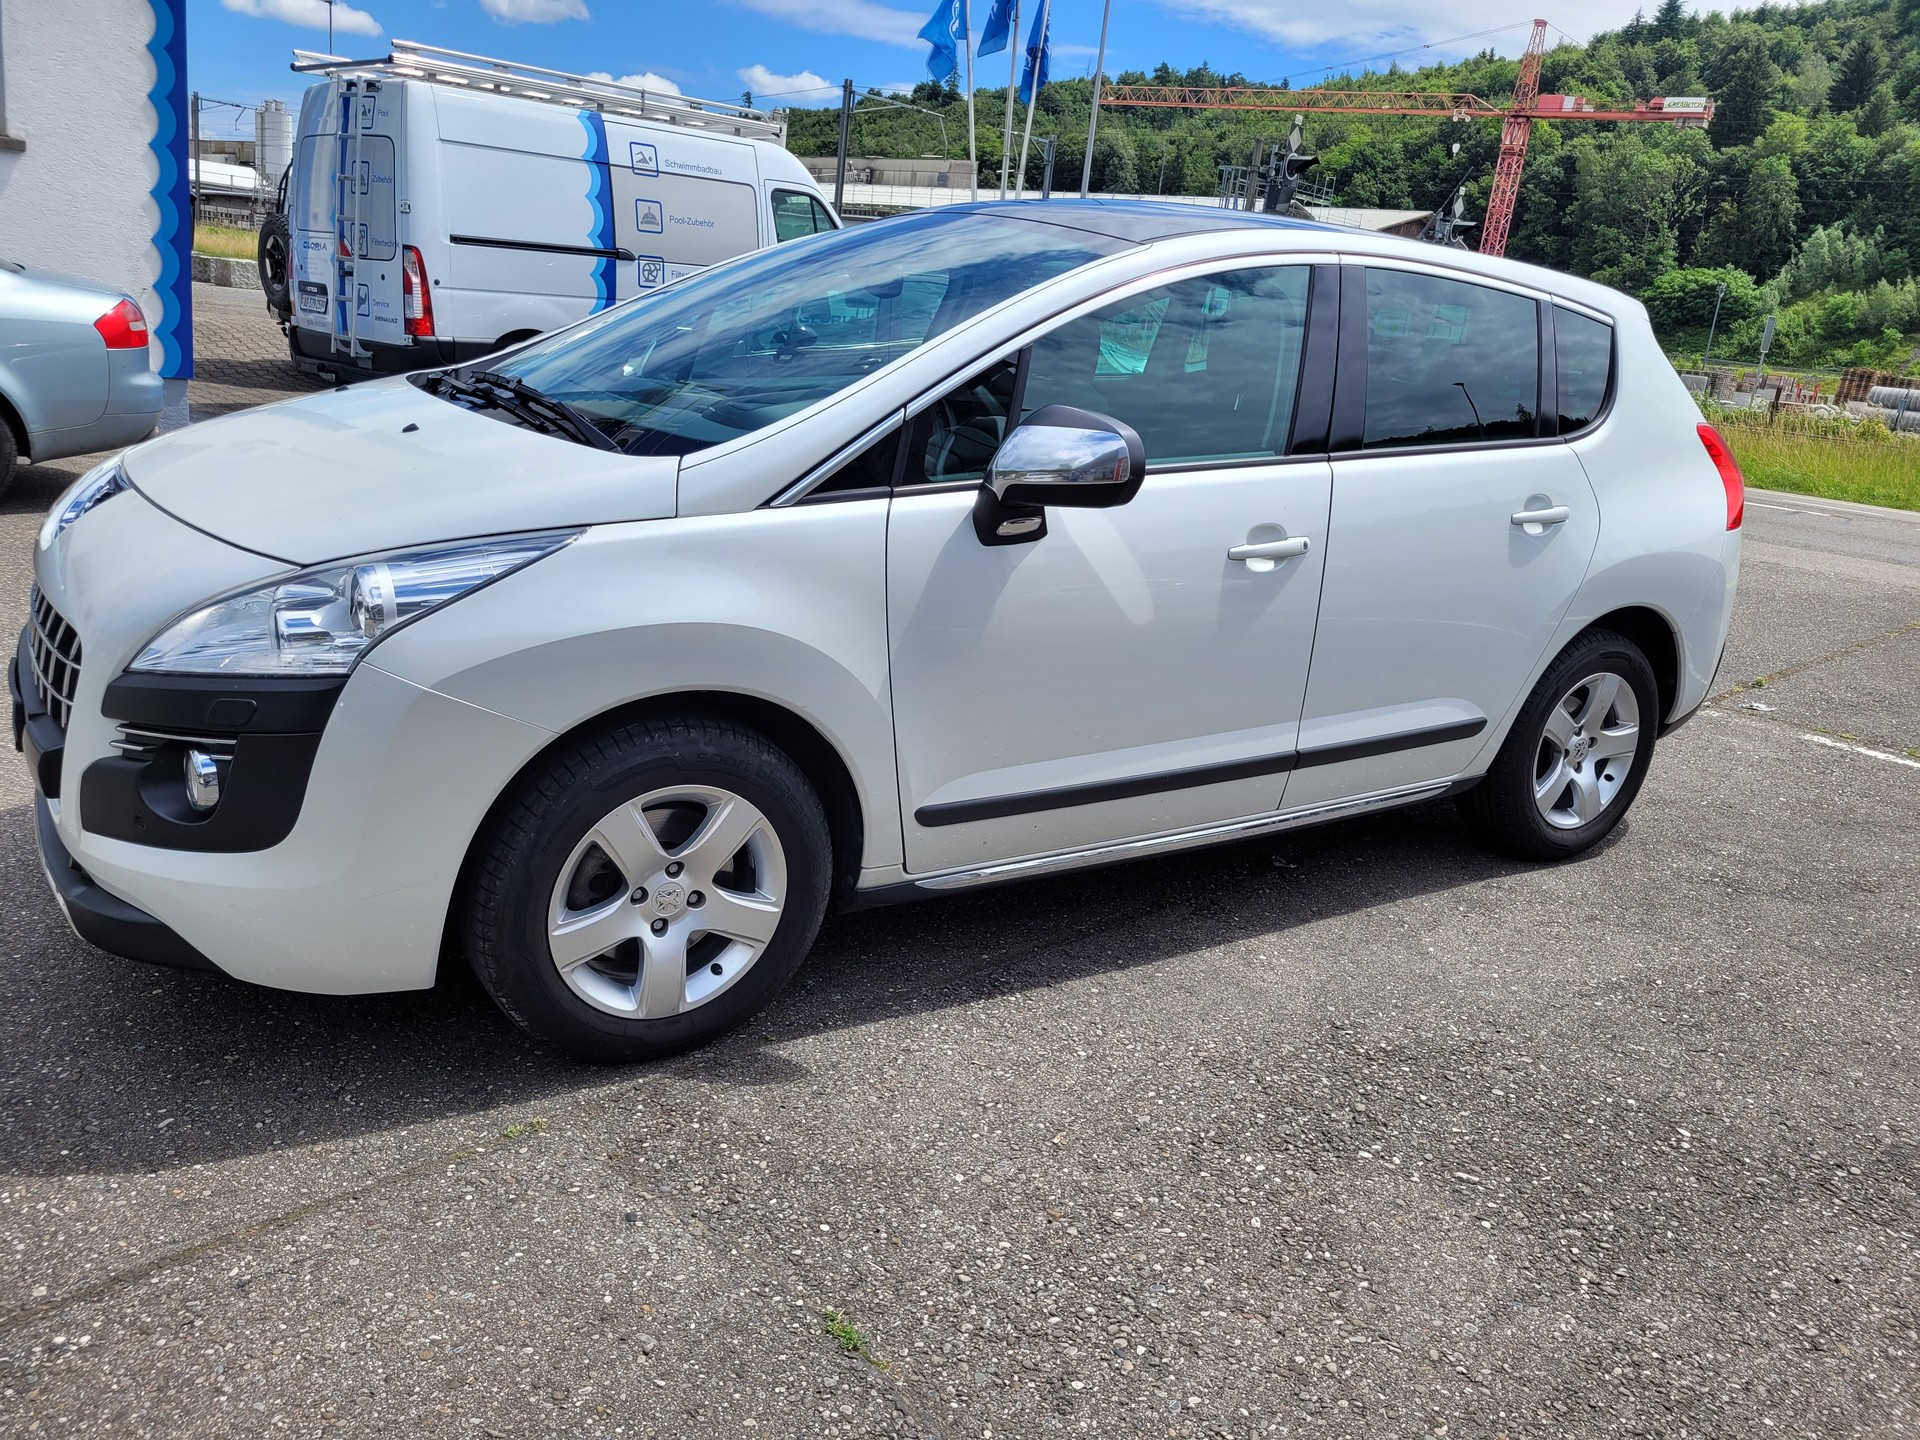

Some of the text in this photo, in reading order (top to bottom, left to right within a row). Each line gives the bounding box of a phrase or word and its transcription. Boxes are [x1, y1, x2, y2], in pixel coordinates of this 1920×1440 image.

[377, 109, 389, 117] Pool
[664, 159, 722, 176] Schwimmbadbau
[372, 174, 393, 184] Zubehör
[669, 215, 715, 228] Pool-Zubehör
[303, 241, 328, 251] GLORIA
[372, 298, 390, 309] Service
